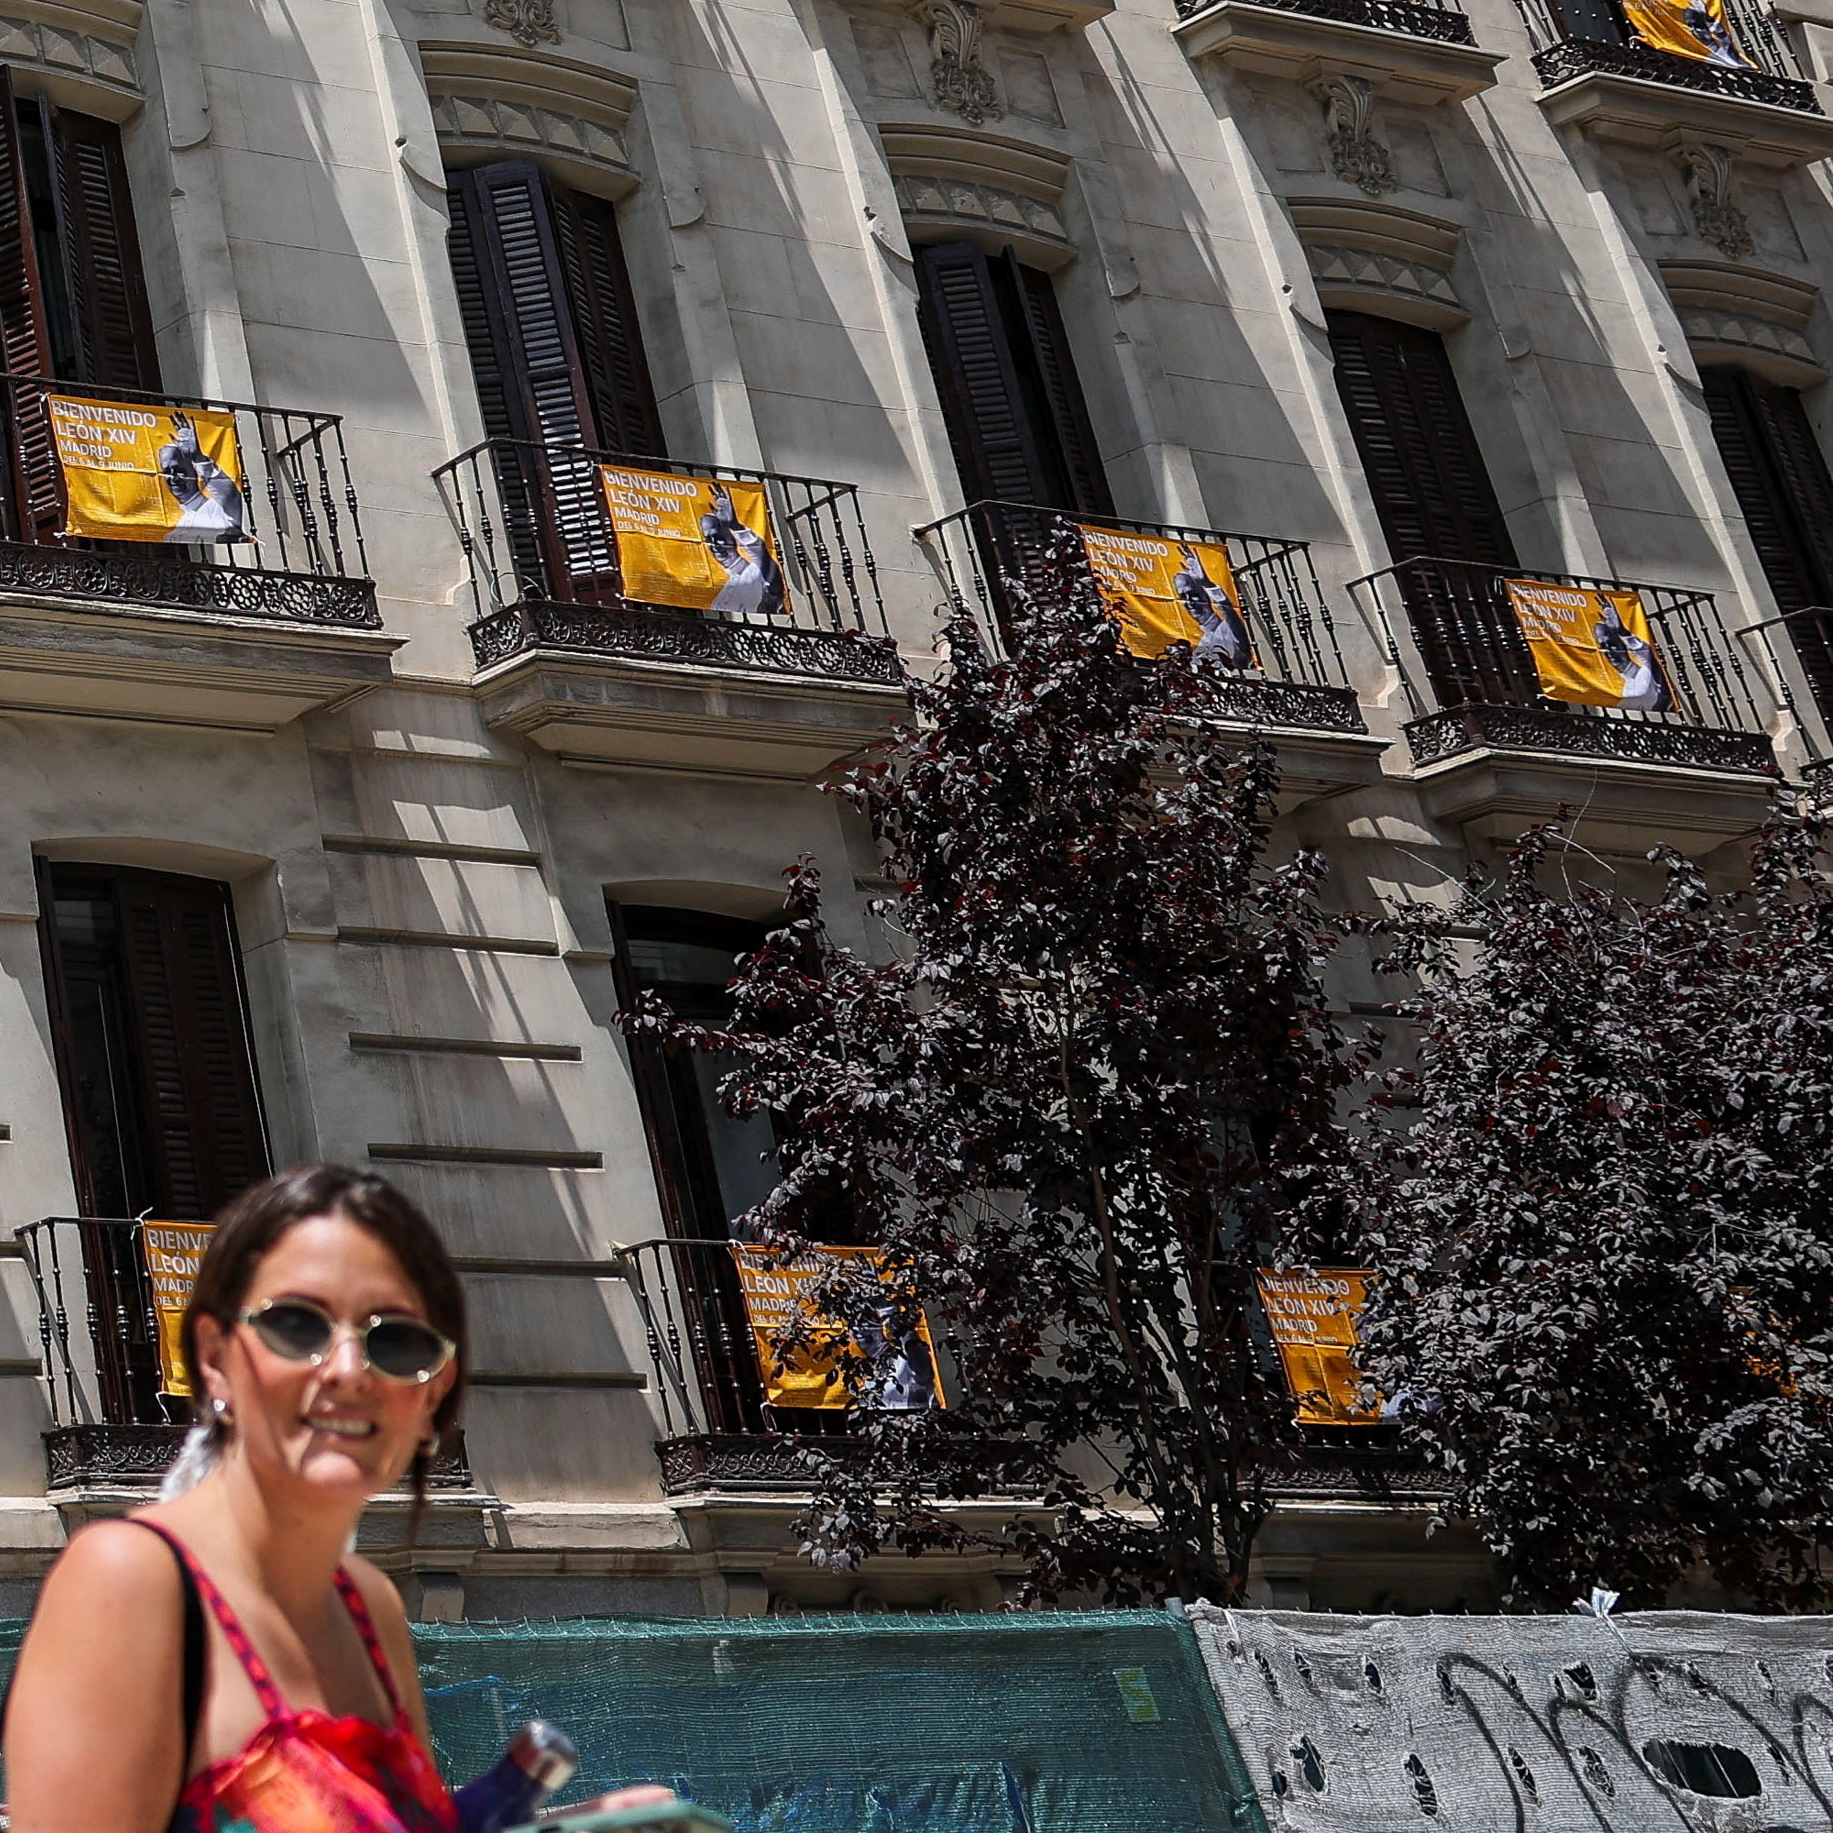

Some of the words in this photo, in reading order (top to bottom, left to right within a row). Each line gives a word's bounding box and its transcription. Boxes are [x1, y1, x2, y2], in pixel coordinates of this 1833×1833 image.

[52, 400, 157, 428] BIENVENIDO
[56, 418, 101, 440] LEÓN
[107, 429, 136, 444] XIV
[62, 438, 113, 459] MADRID
[605, 471, 697, 497] BIENVENIDO
[610, 489, 650, 508] LEÓN
[656, 499, 681, 513] XIV
[615, 507, 660, 526] MADRID
[1083, 531, 1169, 557] BIENVENIDO
[1090, 548, 1126, 569] LEÓN
[1132, 557, 1154, 573] XIV
[1552, 608, 1576, 623] XIV
[148, 1229, 211, 1252] BIENVE
[151, 1248, 201, 1274] LEÓN
[153, 1277, 195, 1293] MADR
[745, 1271, 791, 1294] LEÓN
[155, 1295, 174, 1305] DEL
[176, 1295, 182, 1305] 6
[1266, 1296, 1309, 1316] LEÓN
[1272, 1317, 1317, 1334] MADRID
